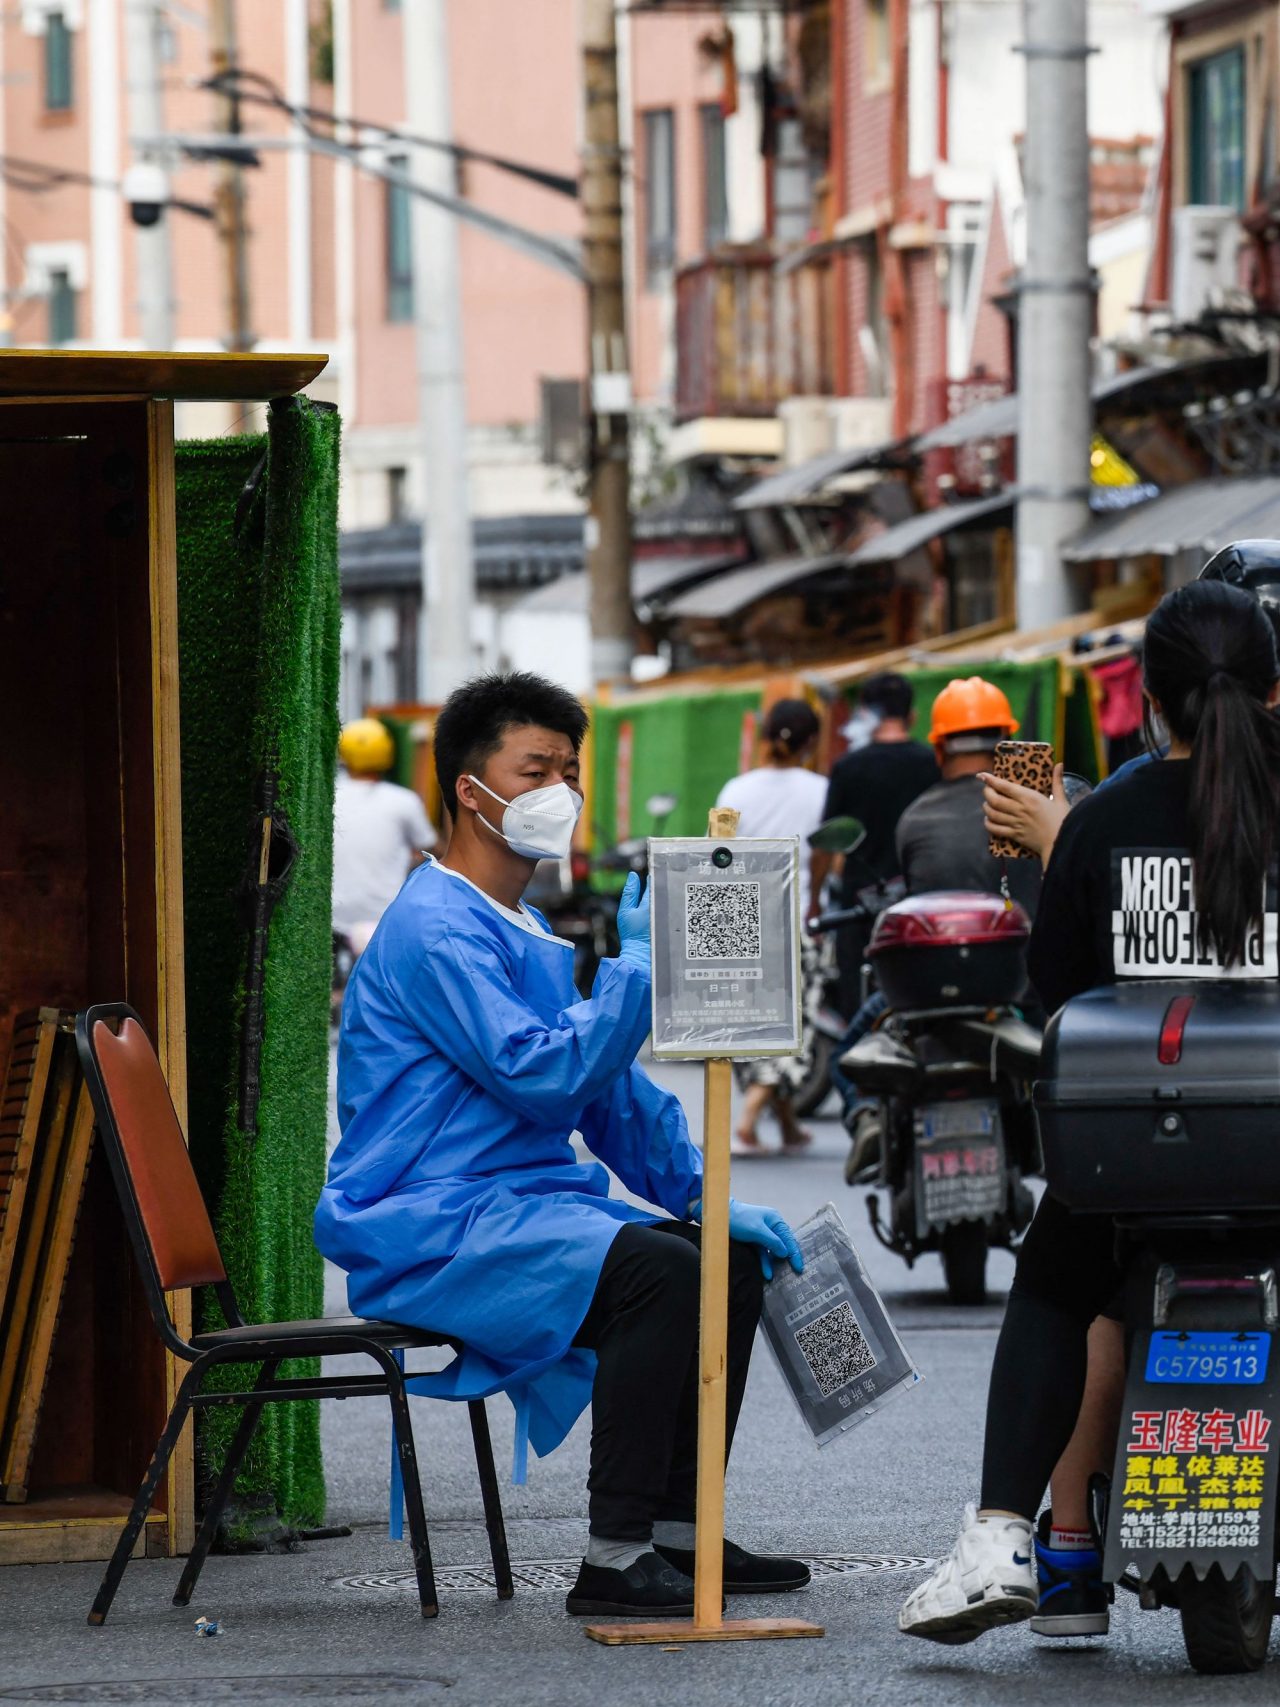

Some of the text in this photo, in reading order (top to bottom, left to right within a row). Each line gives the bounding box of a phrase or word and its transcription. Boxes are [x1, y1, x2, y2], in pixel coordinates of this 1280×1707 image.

[1154, 1356, 1258, 1378] C579513
[838, 1378, 876, 1408] 场所码
[1127, 1408, 1271, 1454] 玉隆车业
